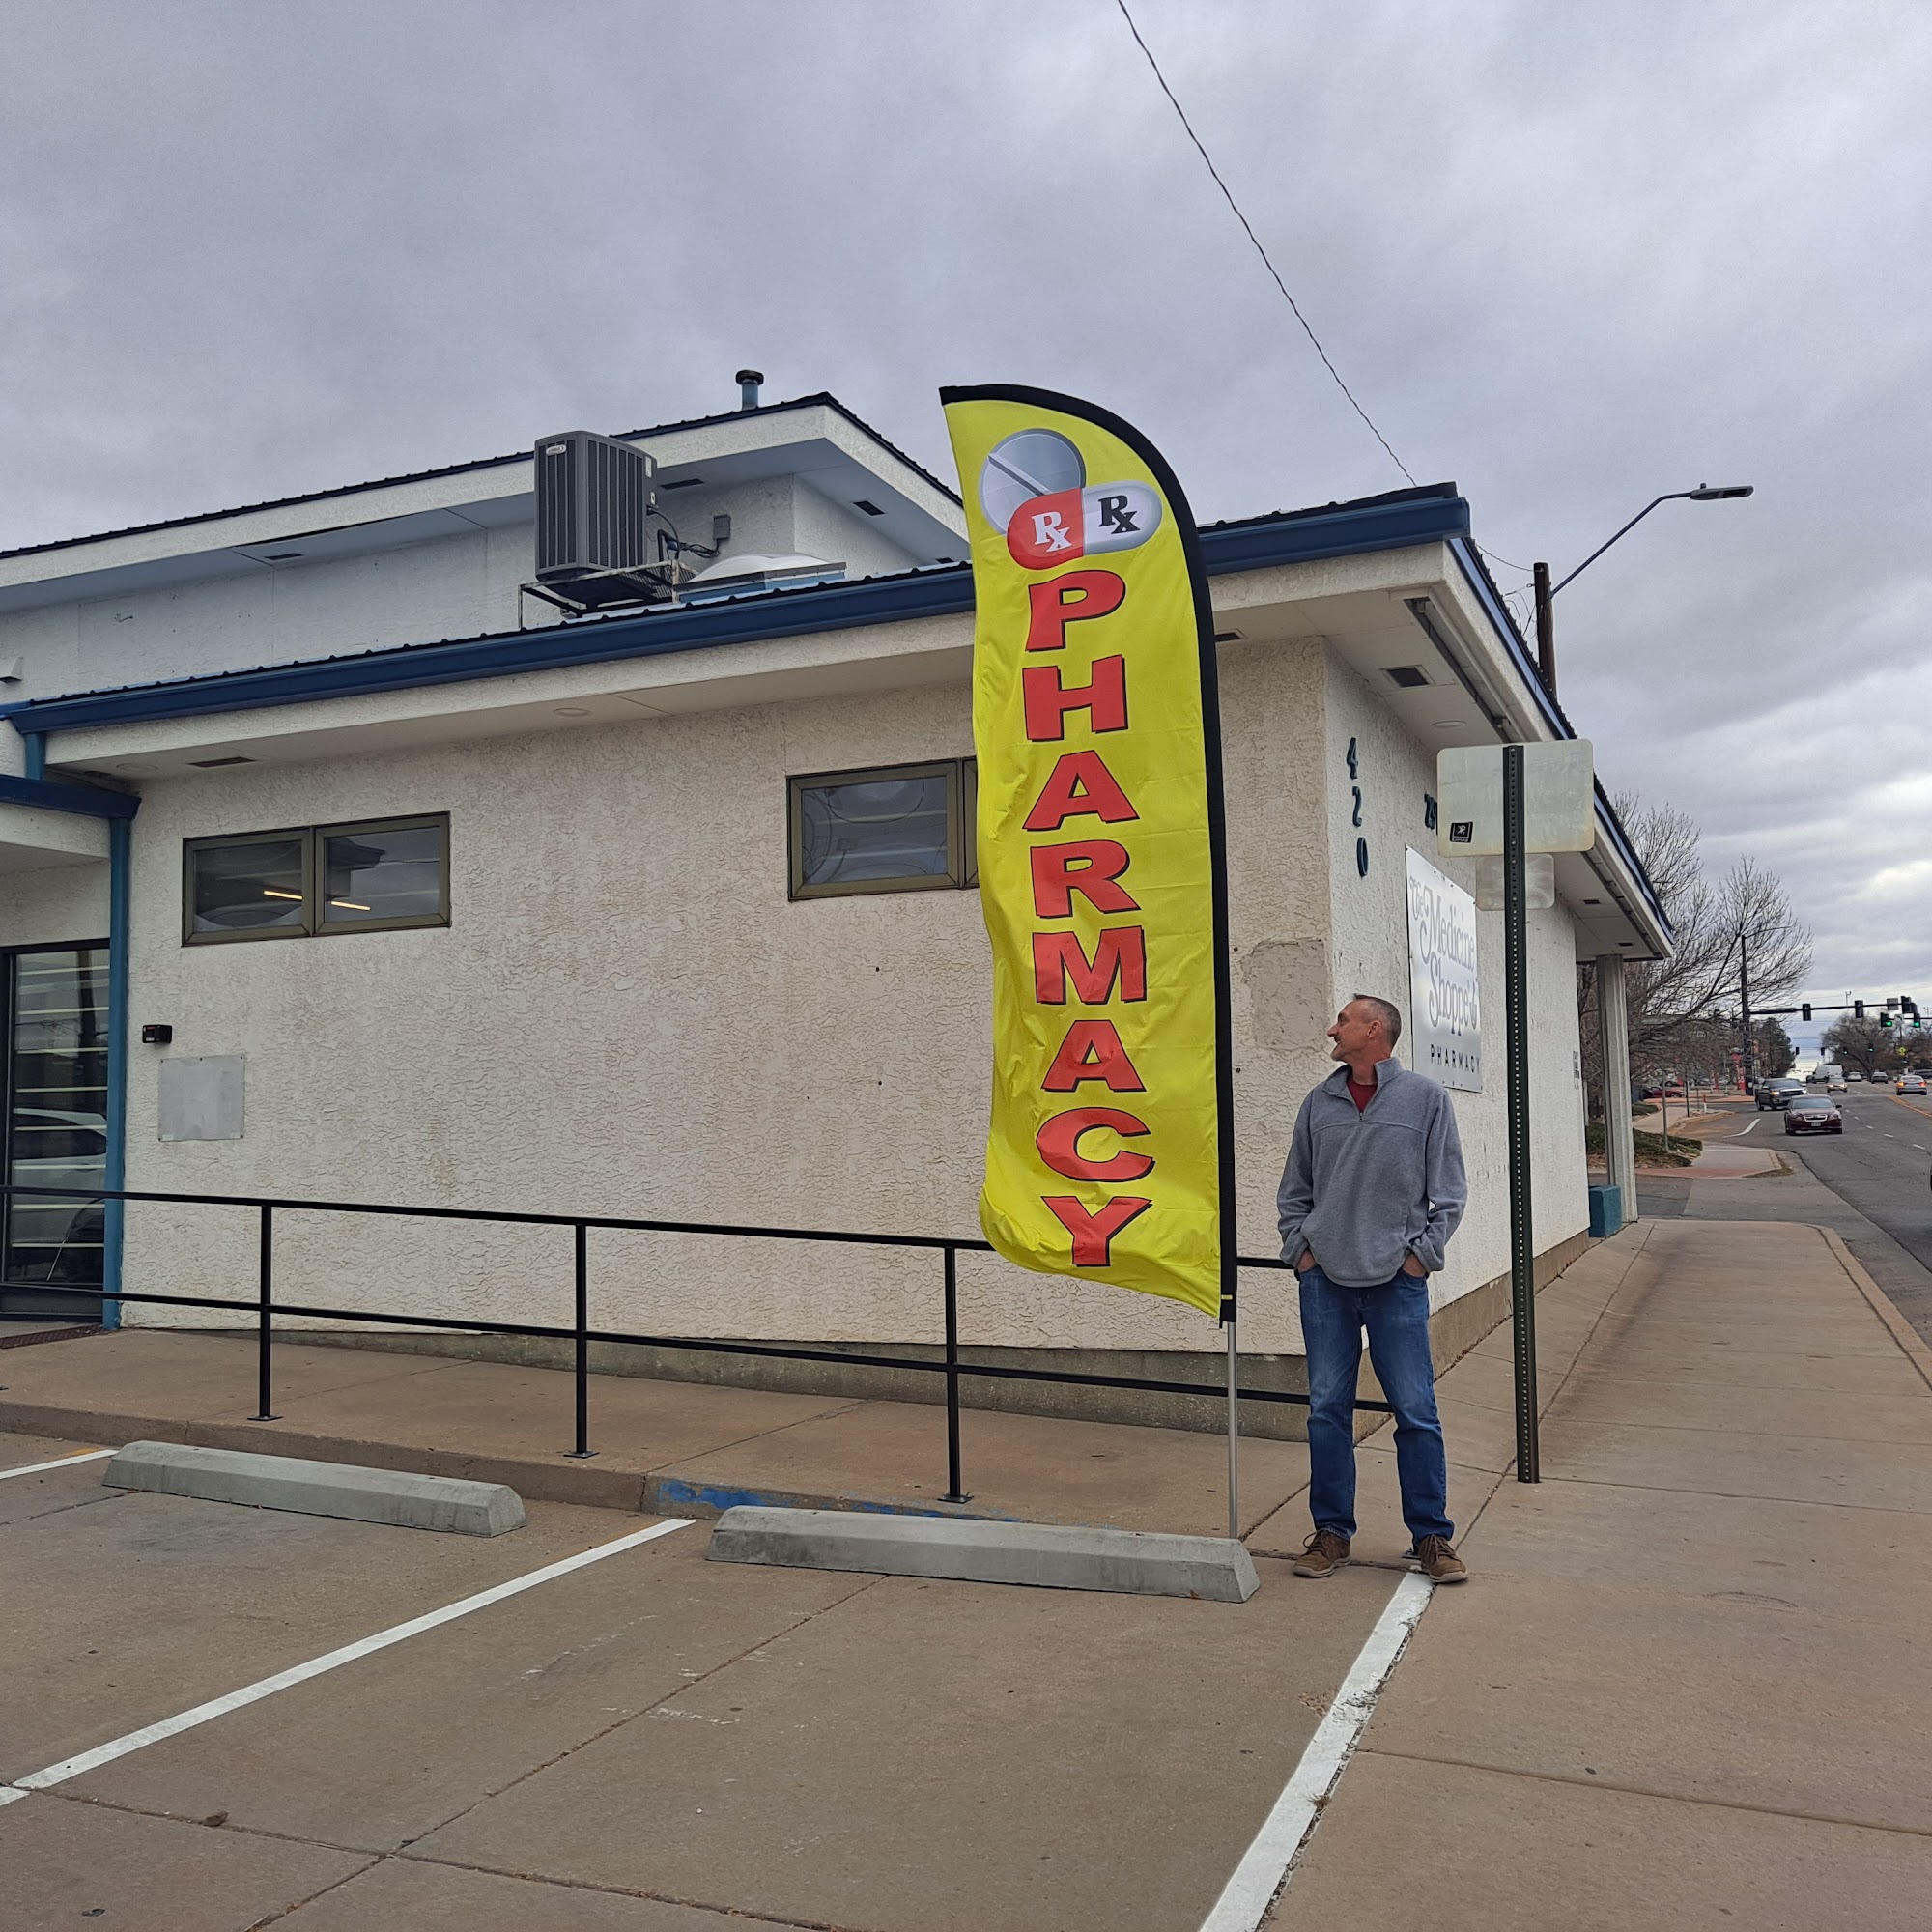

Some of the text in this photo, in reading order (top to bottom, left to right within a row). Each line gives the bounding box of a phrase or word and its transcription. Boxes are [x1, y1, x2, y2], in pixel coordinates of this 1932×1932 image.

[1346, 737, 1369, 877] 420
[1021, 569, 1155, 1267] PHARMACY
[1420, 885, 1475, 973] Medicine
[1430, 1044, 1481, 1074] PHARMACY
